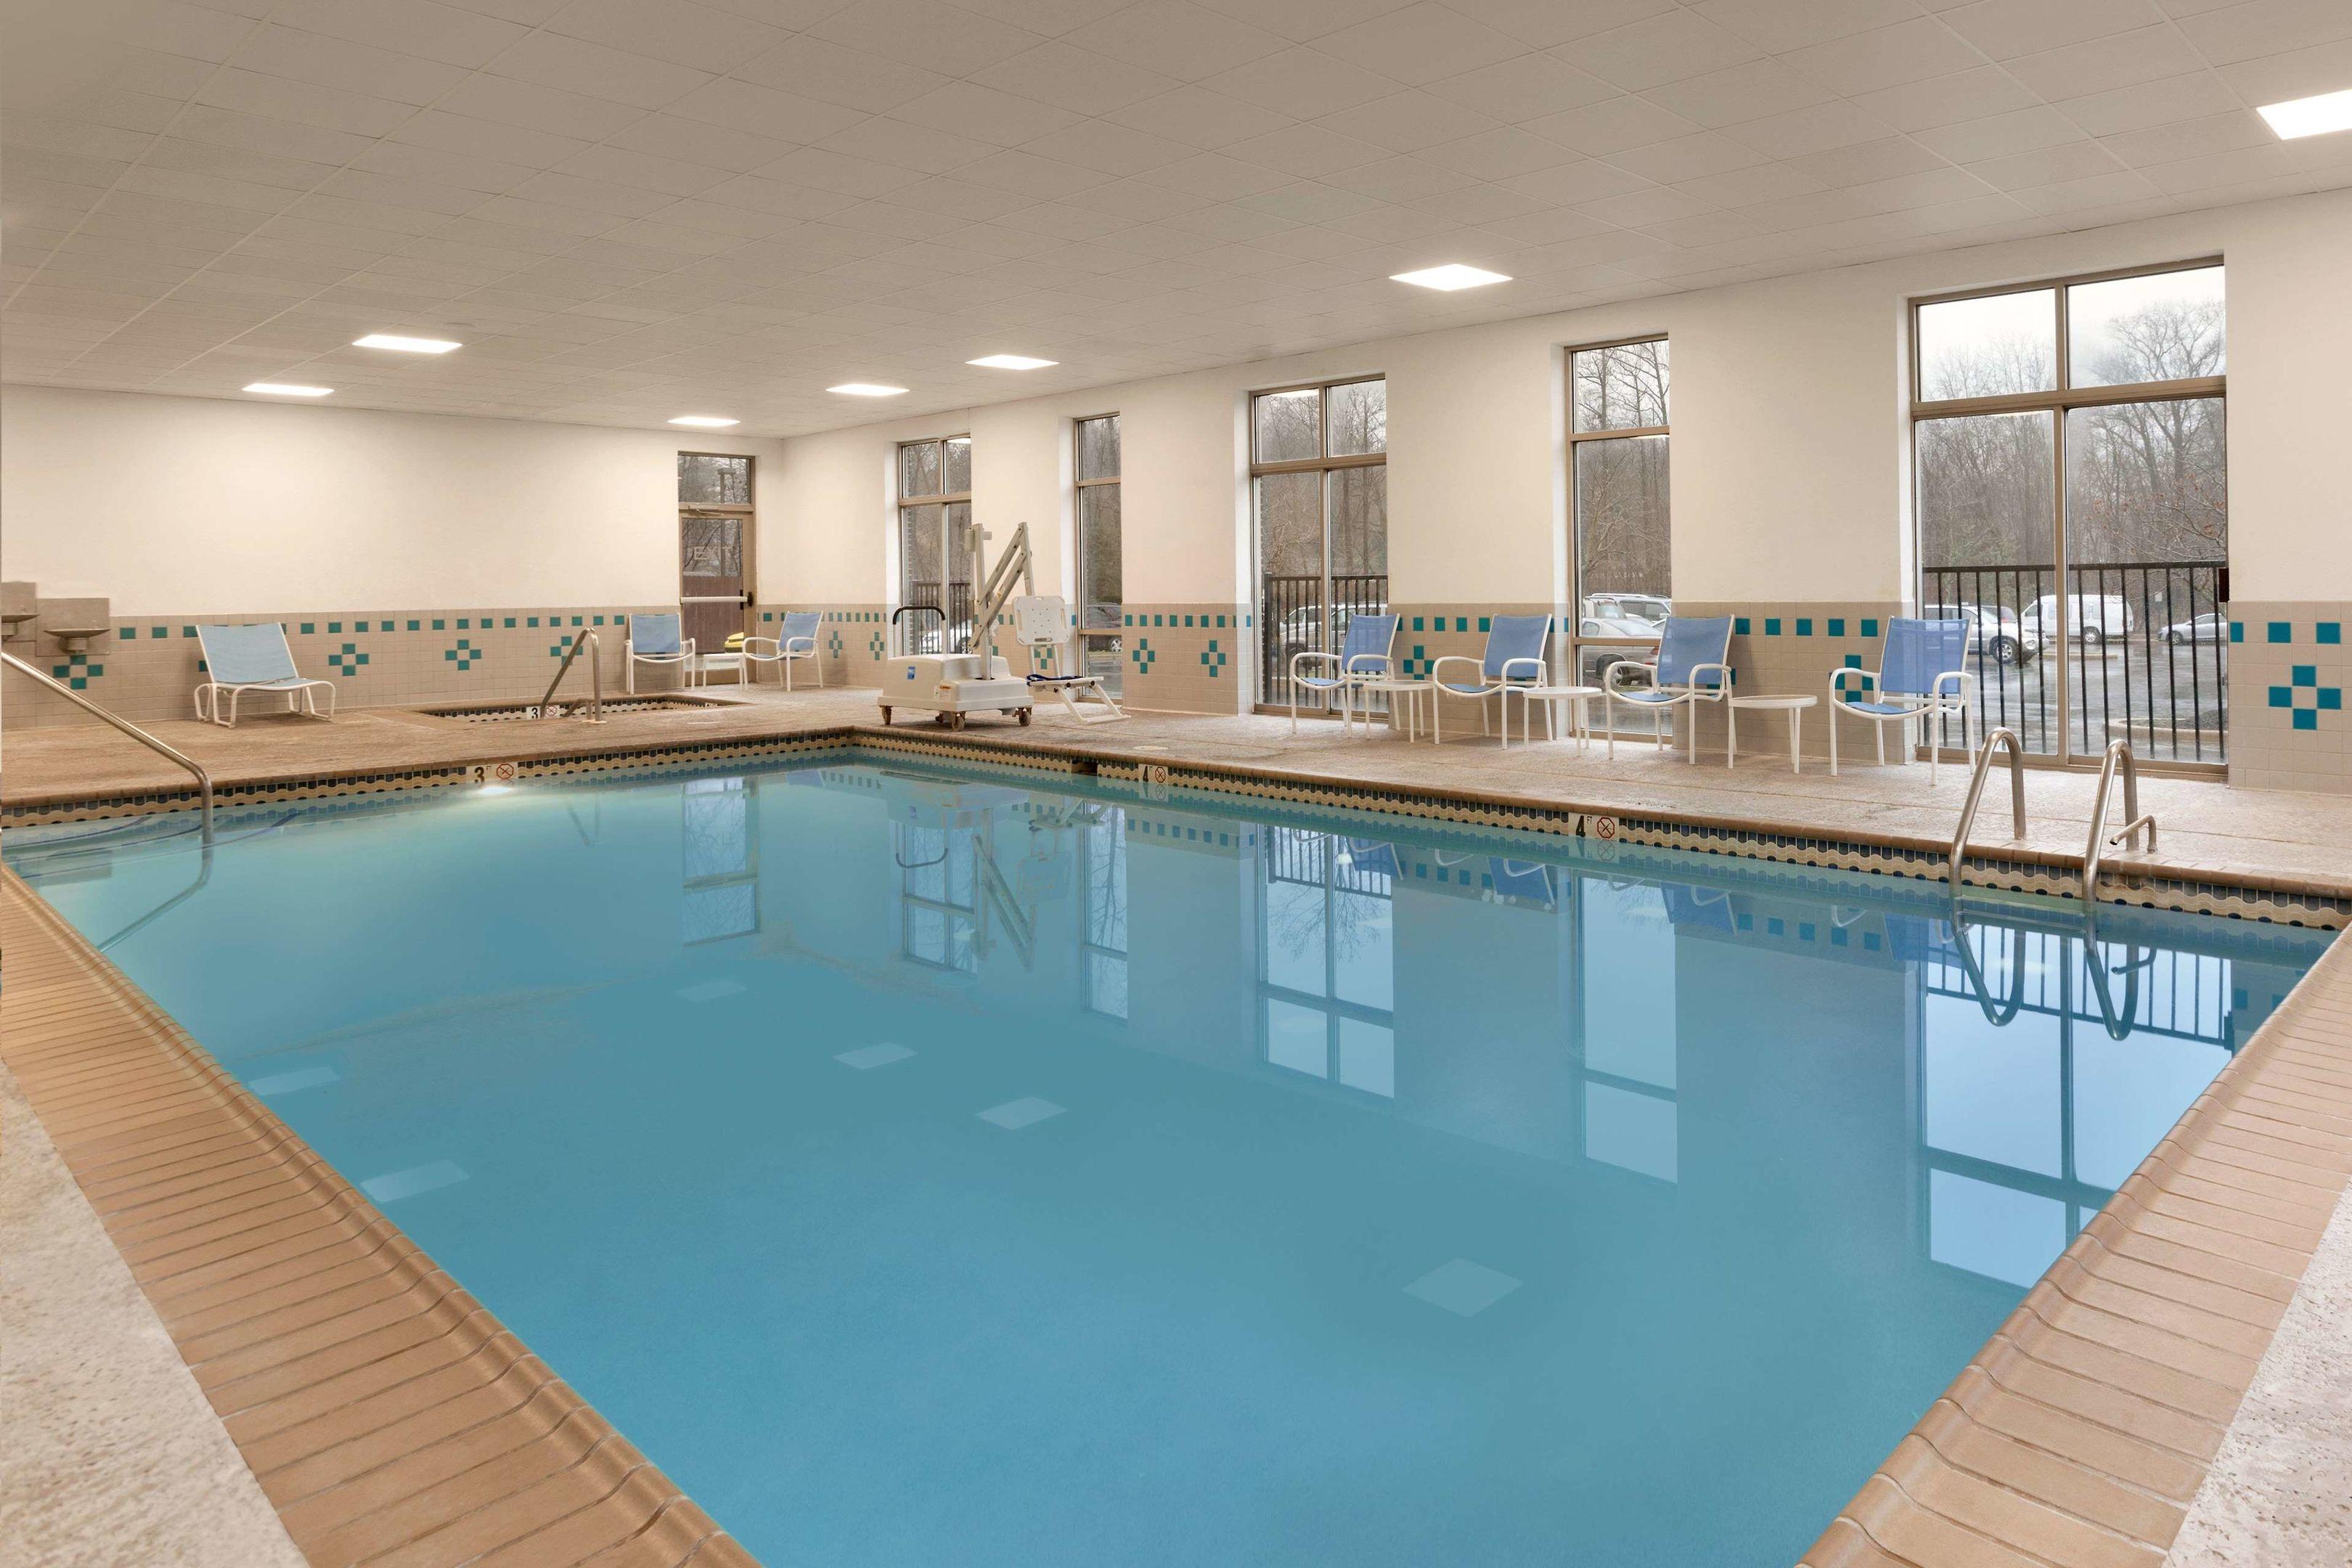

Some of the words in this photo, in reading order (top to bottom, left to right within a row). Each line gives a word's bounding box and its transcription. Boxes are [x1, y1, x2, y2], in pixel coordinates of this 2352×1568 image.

[531, 707, 538, 719] 3
[474, 767, 485, 783] 3
[1143, 765, 1149, 783] 4
[1575, 814, 1586, 838] 4
